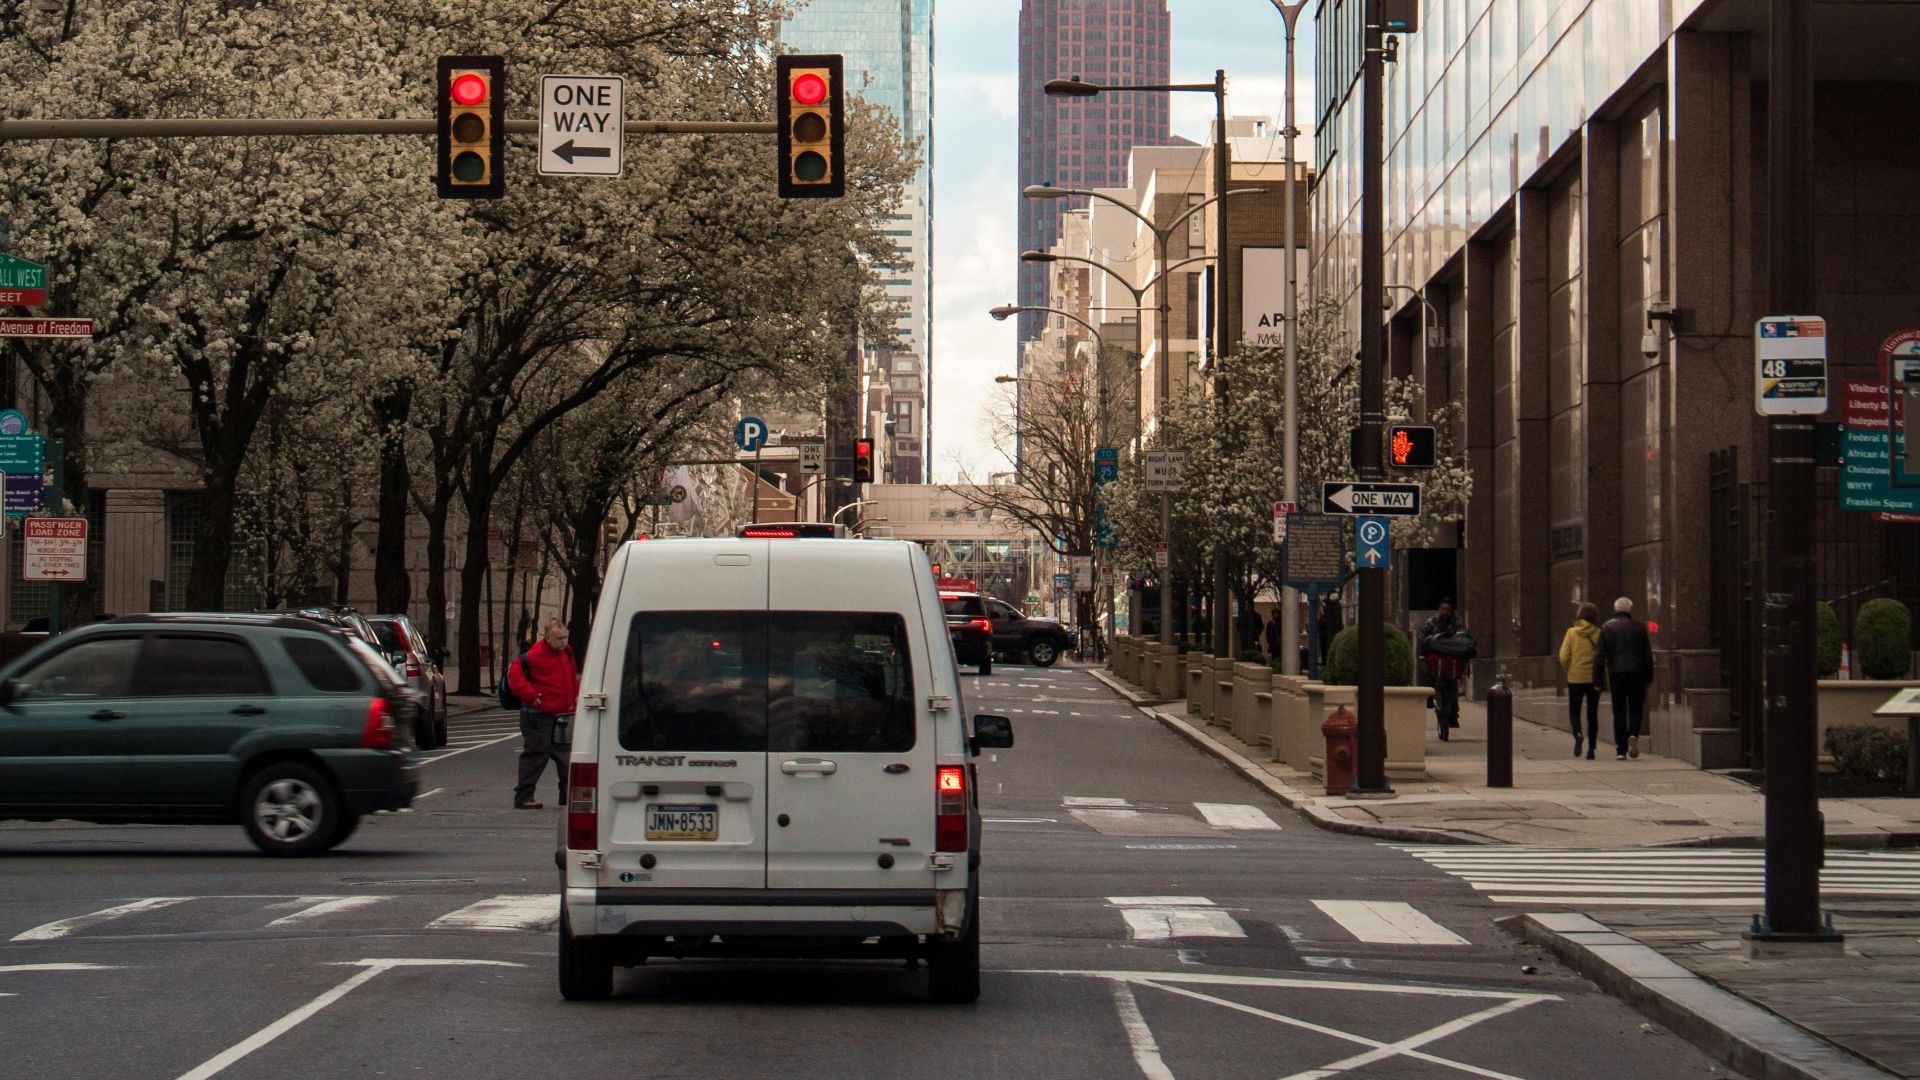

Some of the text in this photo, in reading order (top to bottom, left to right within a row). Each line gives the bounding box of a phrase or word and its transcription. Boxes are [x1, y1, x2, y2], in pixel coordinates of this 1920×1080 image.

[554, 85, 611, 106] ONE
[553, 112, 610, 132] WAY
[18, 269, 42, 287] WEST
[0, 321, 90, 335] Avenue of Freedom
[1763, 360, 1786, 377] 48
[1849, 383, 1878, 393] Visitor
[1849, 400, 1879, 412] Liberty
[744, 422, 761, 446] P
[1848, 433, 1880, 442] Federal
[804, 445, 821, 453] ONE
[1847, 450, 1877, 459] African
[803, 454, 821, 462] WAY
[1352, 493, 1409, 505] ONE WAY
[1846, 498, 1913, 509] Franklin Square
[31, 521, 81, 529] PASSENGER
[616, 755, 686, 766] TRANSIT
